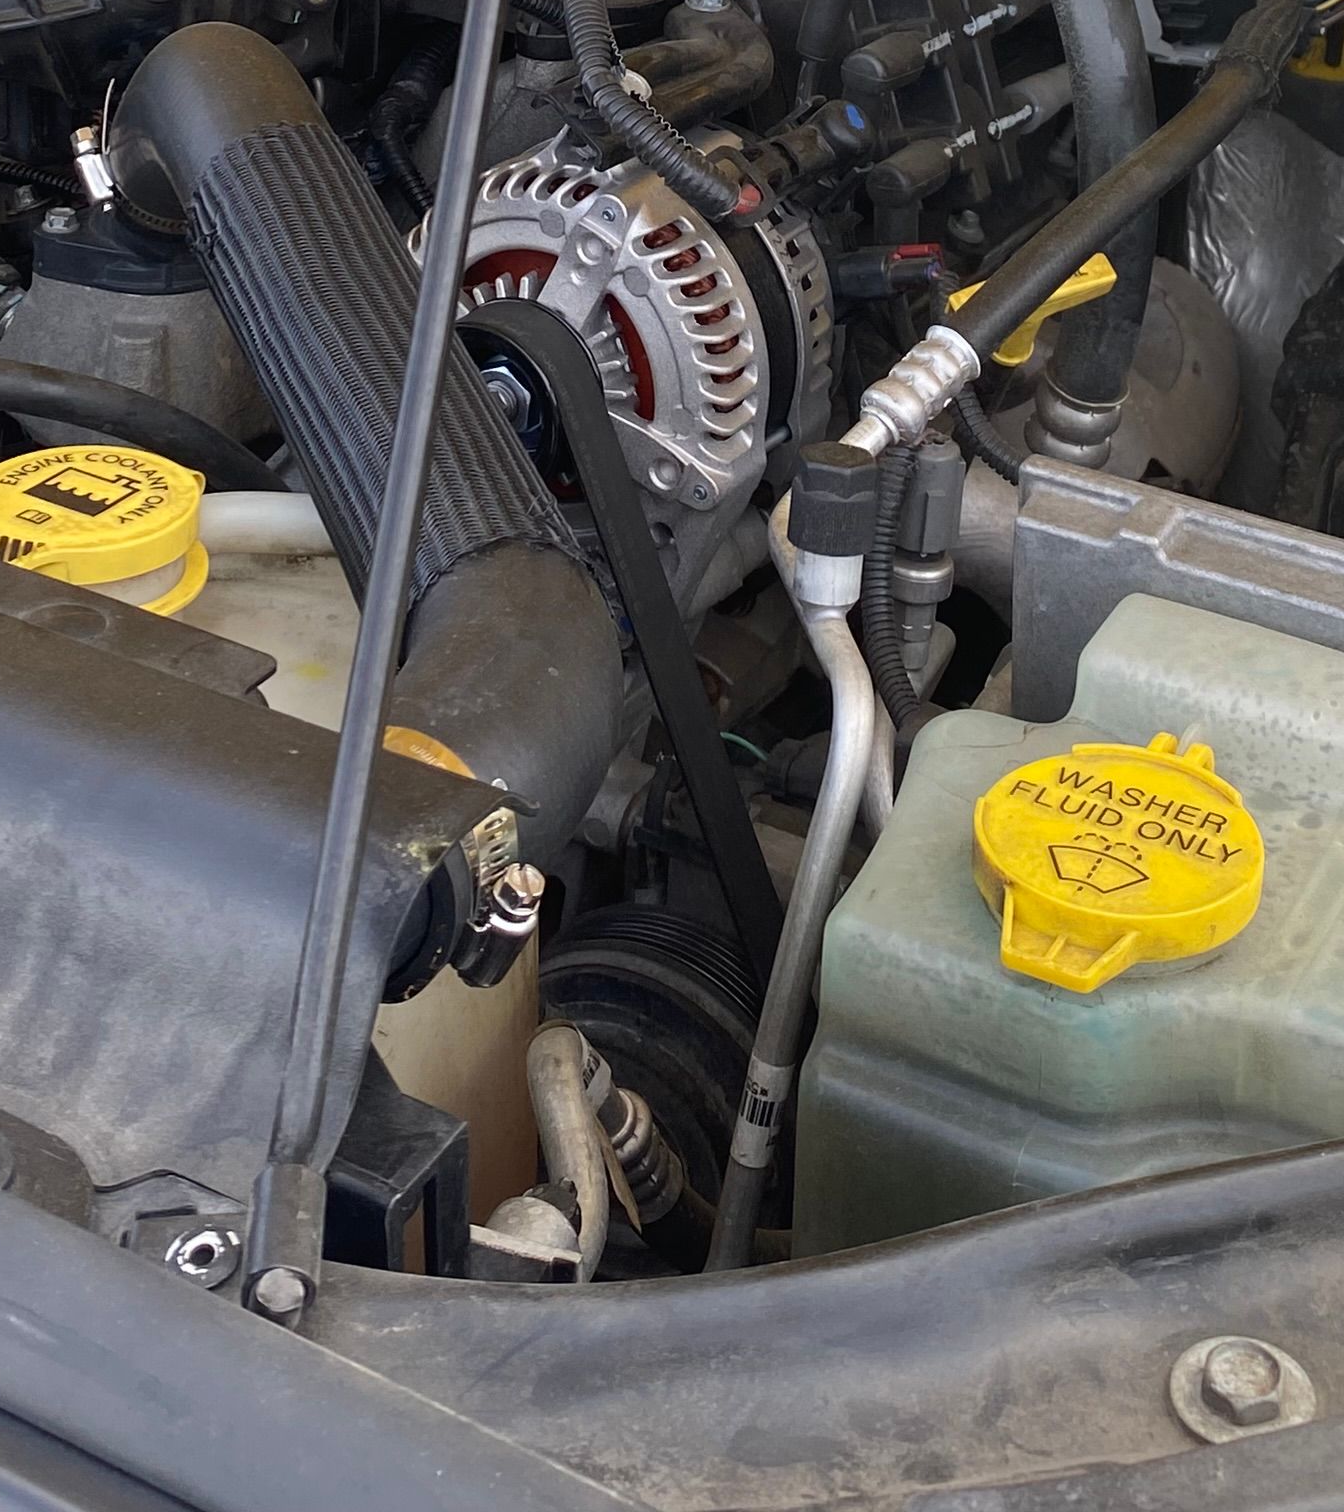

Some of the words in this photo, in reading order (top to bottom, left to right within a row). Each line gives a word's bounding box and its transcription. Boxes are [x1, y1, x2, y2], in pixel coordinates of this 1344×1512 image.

[0, 453, 75, 487] ENGINE
[85, 451, 169, 492] COOLANT
[118, 494, 164, 525] ONLY
[1056, 765, 1229, 835] WASHER
[1008, 779, 1124, 828] FLUID
[1136, 820, 1243, 865] ONLY
